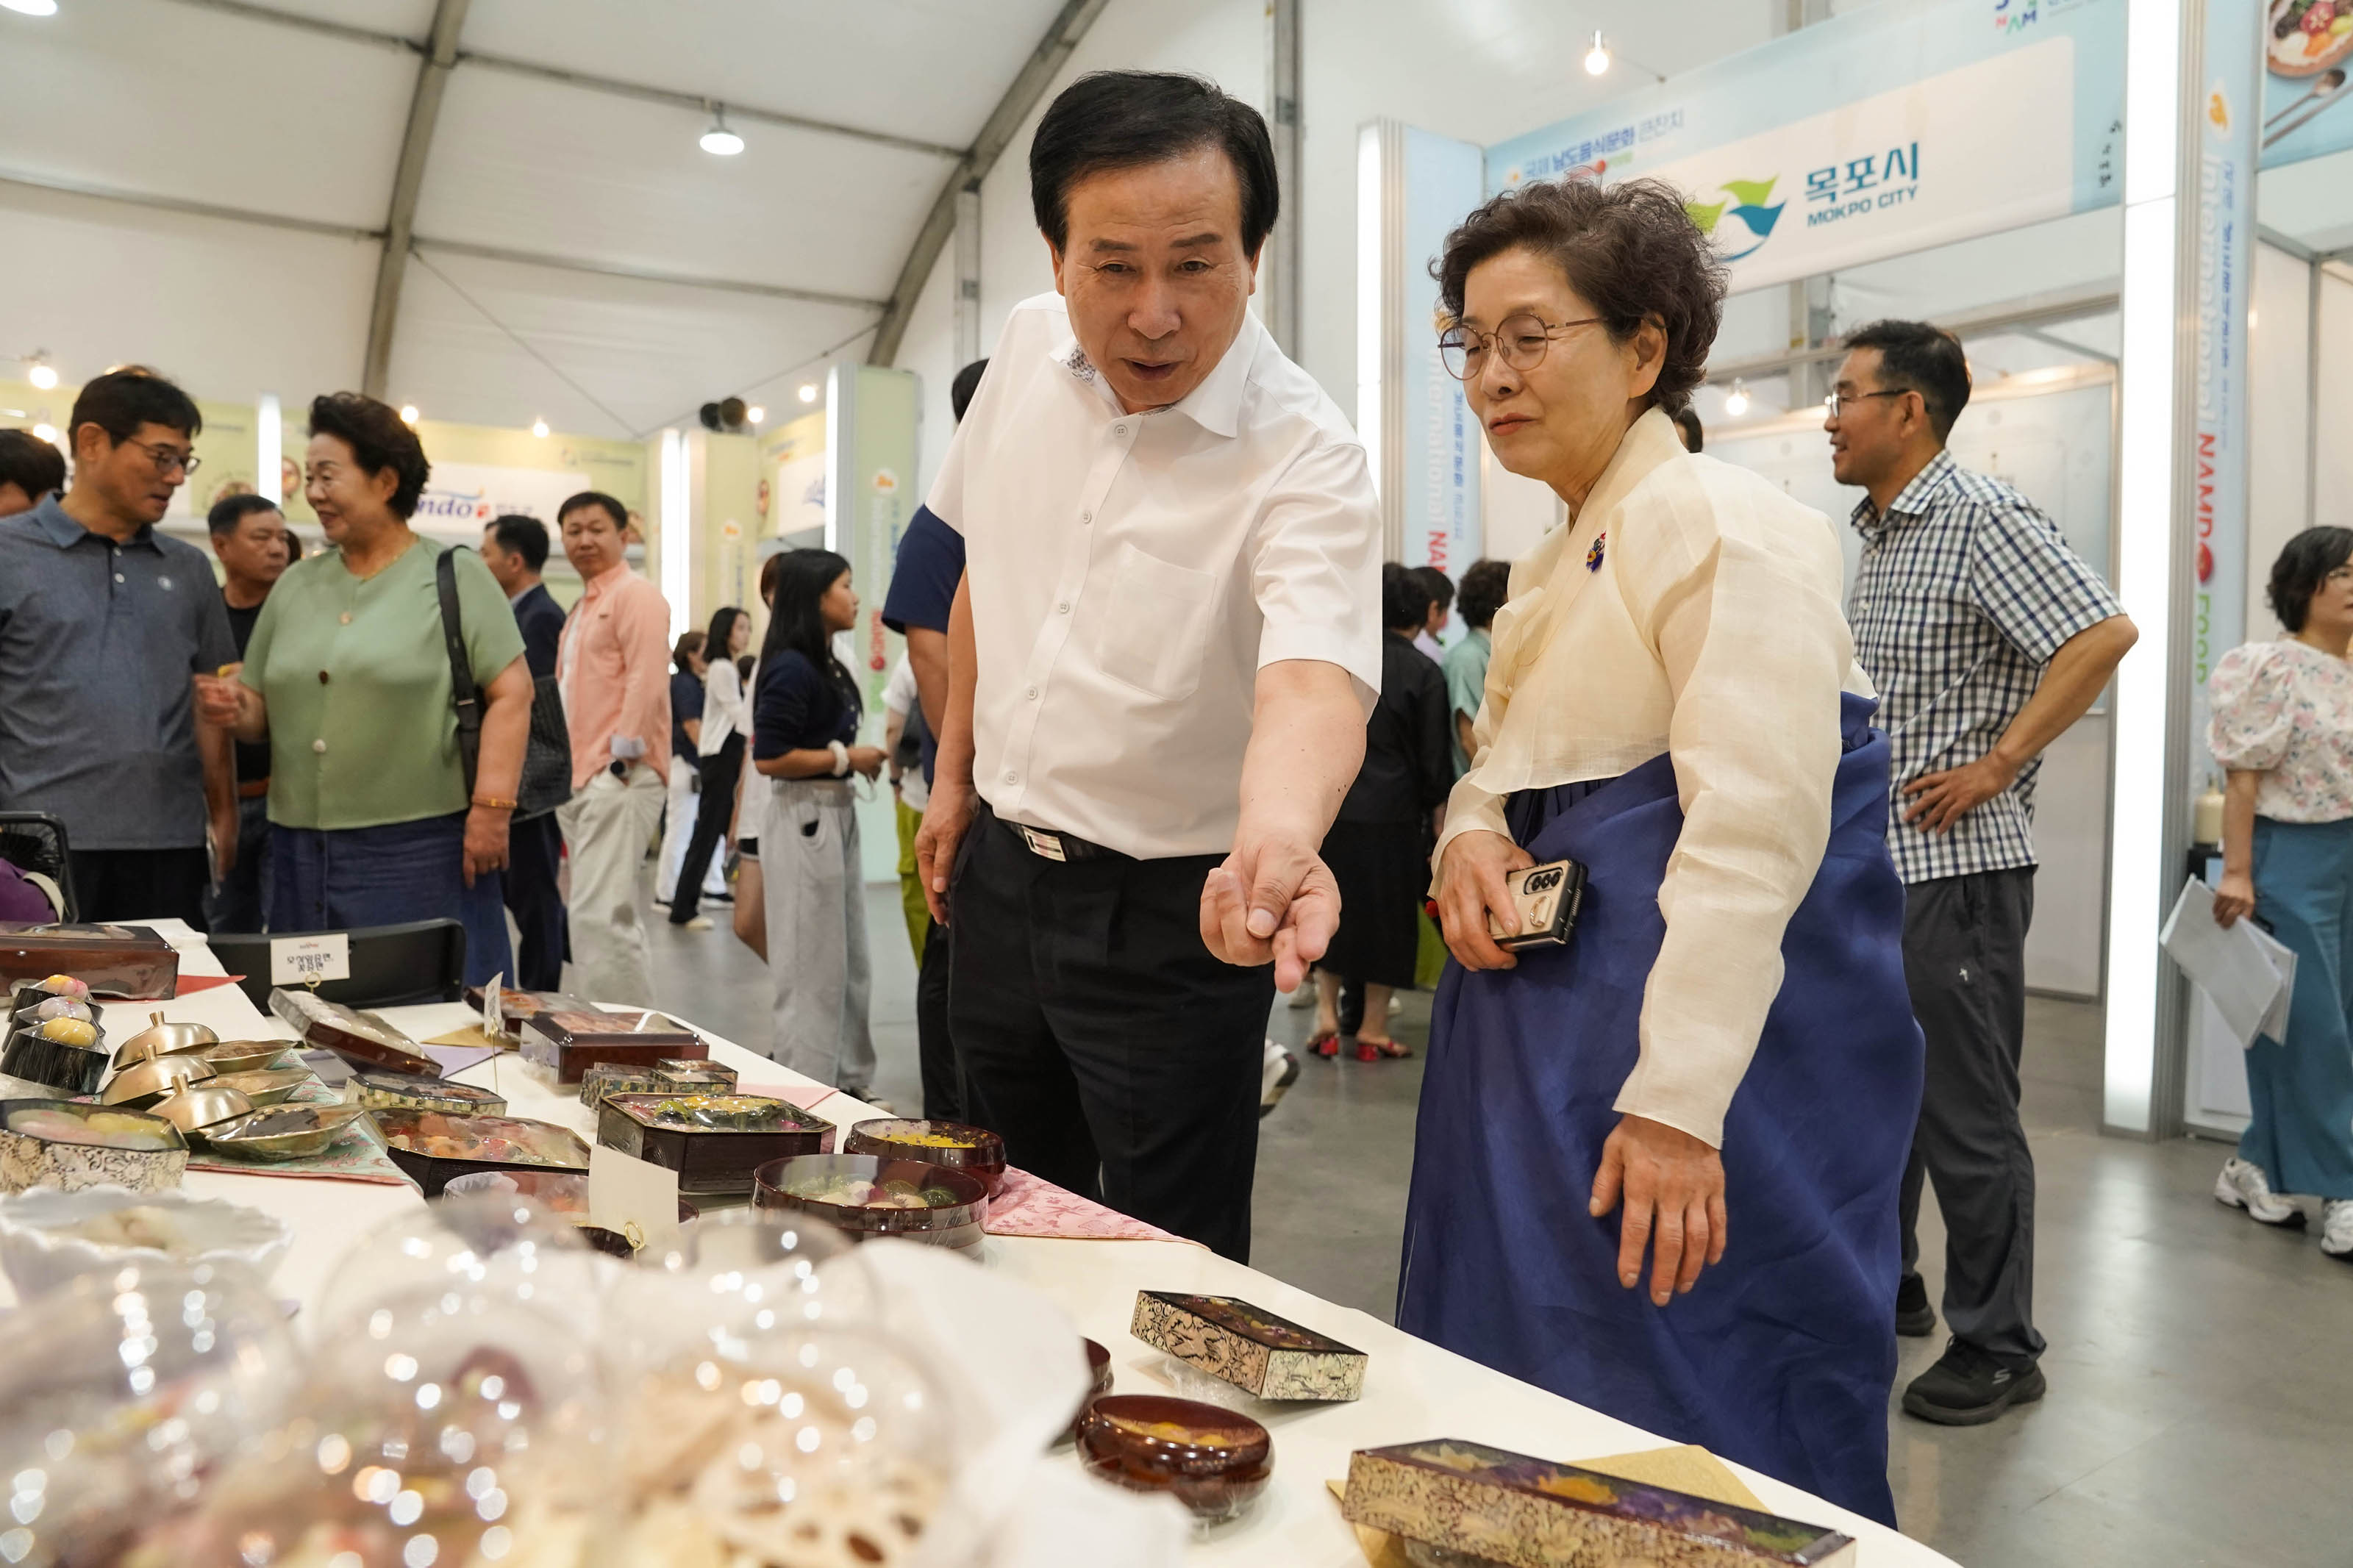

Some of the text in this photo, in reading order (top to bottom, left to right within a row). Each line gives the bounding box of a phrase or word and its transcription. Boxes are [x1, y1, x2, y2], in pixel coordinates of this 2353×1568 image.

[1805, 141, 1918, 203] 목포시
[1807, 185, 1918, 226] MOKPO CITY
